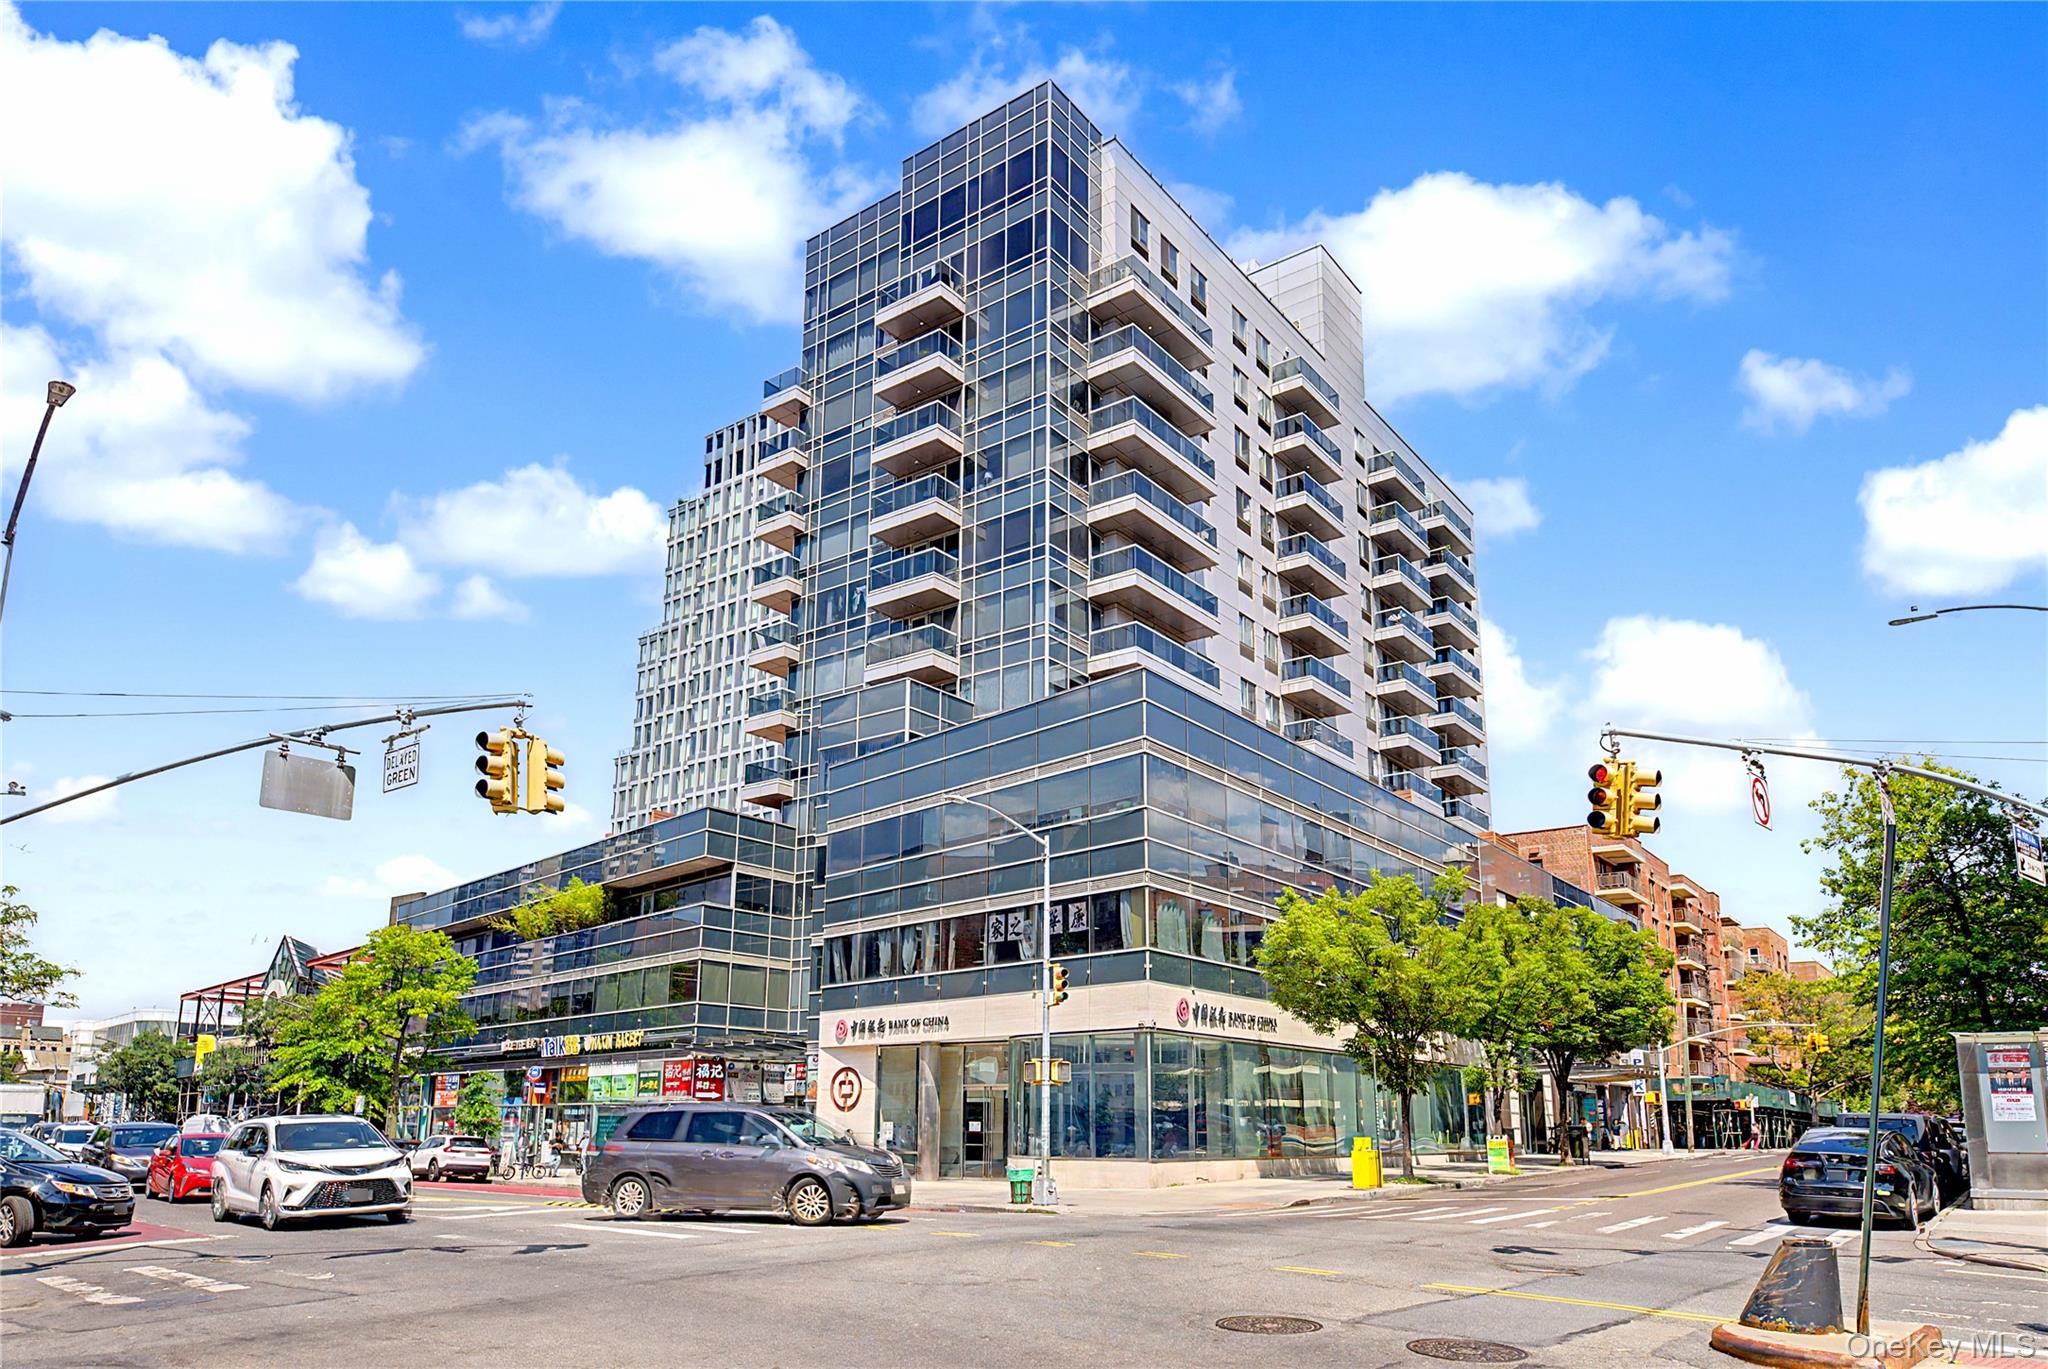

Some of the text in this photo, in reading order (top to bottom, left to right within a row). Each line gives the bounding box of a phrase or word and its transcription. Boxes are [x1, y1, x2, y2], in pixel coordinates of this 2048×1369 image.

[386, 749, 417, 771] DELAYED
[386, 766, 416, 786] GREEN
[888, 1015, 950, 1029] BANK OF CHINA
[1229, 1011, 1278, 1027] BANK OF CHINA
